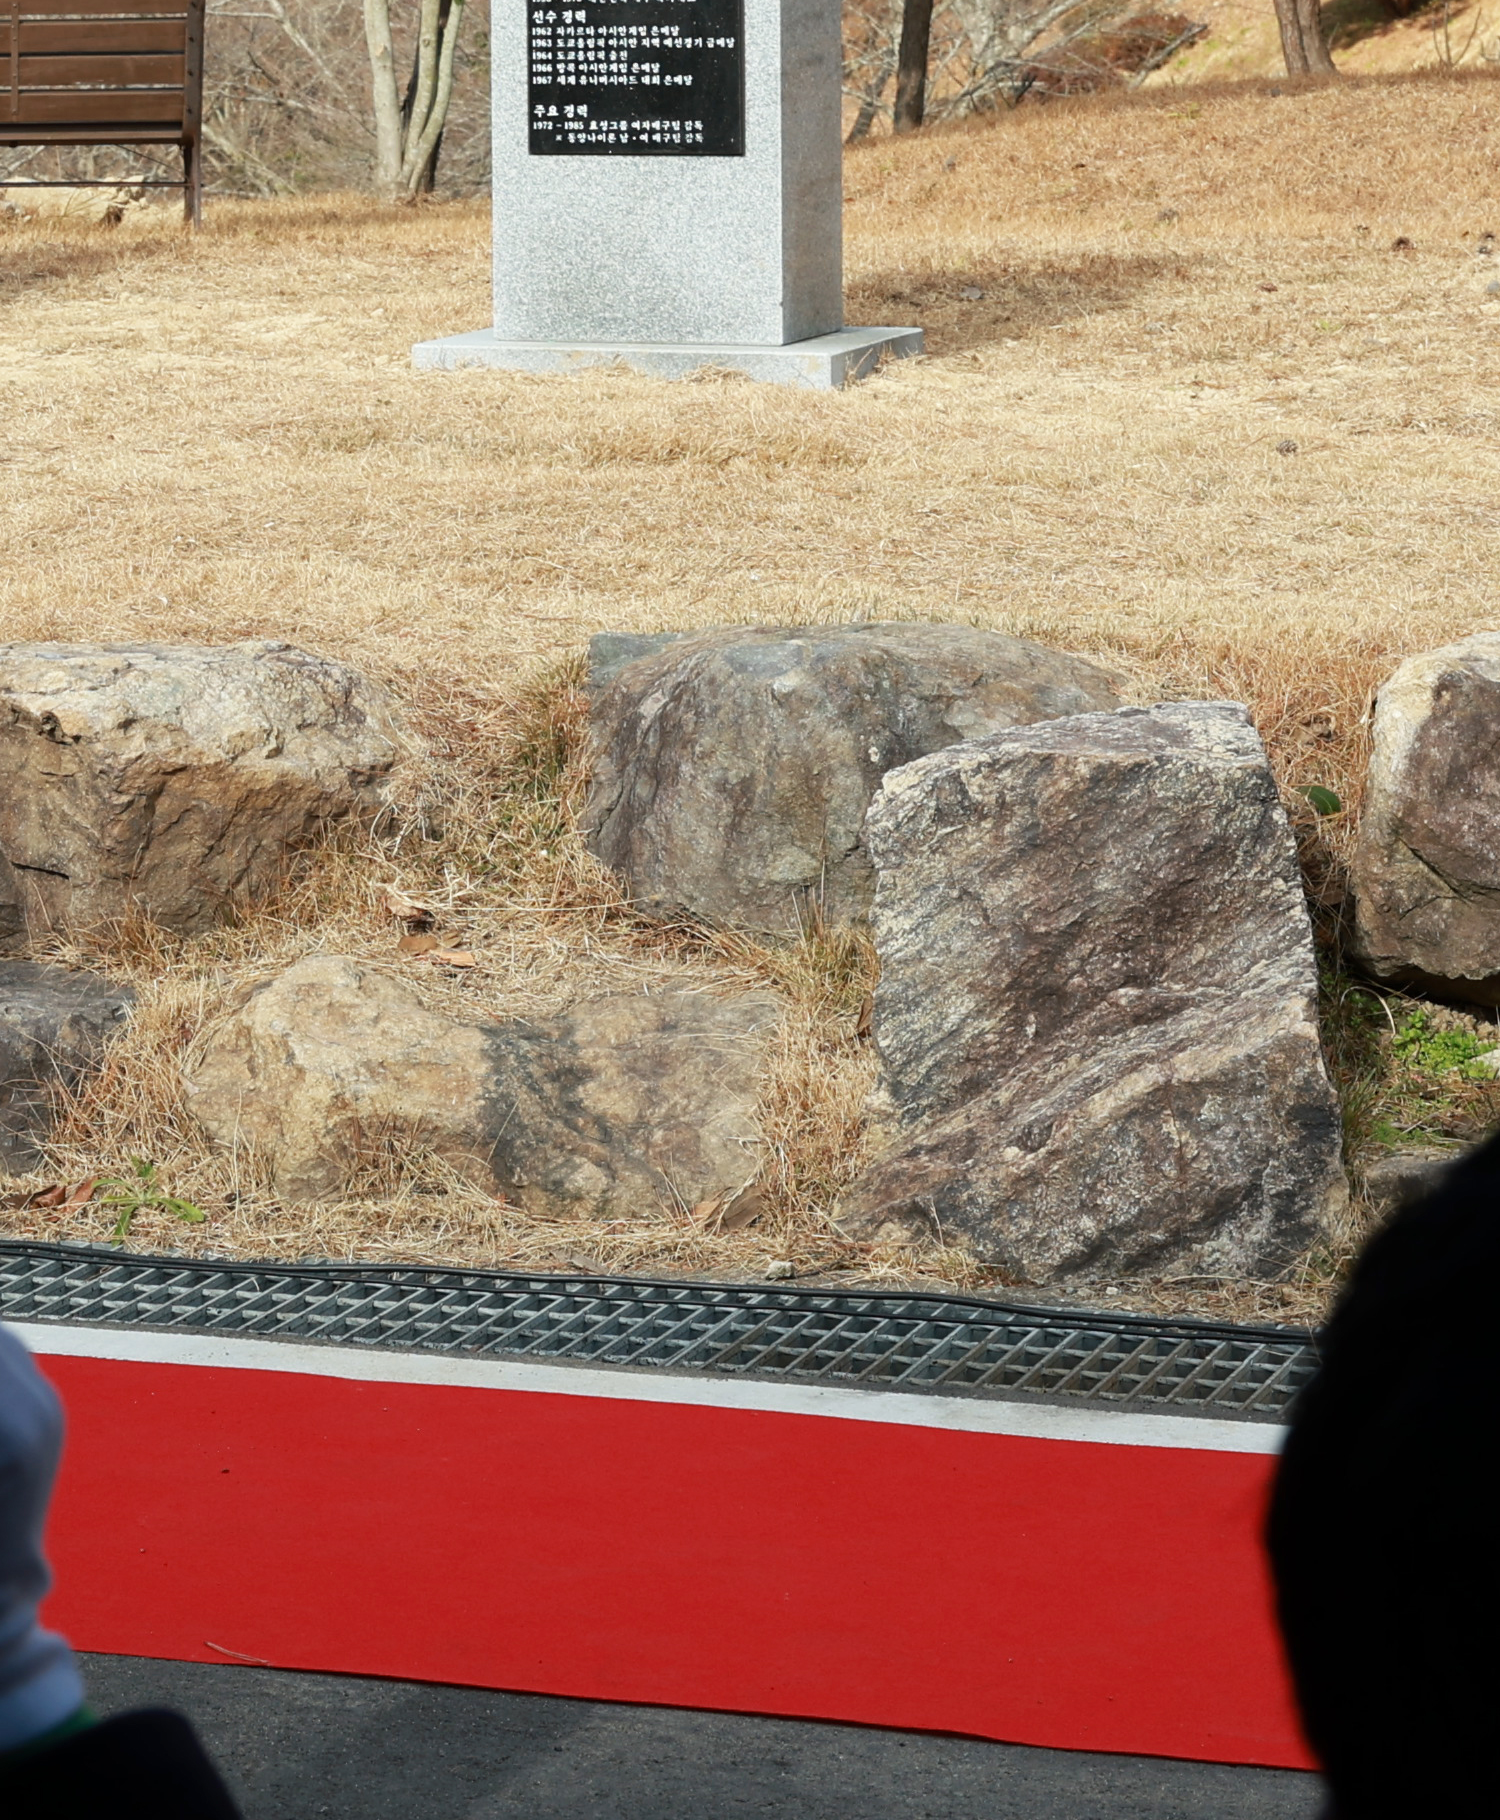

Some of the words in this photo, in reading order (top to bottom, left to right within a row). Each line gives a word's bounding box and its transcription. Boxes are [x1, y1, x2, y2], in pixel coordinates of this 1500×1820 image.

[533, 10, 557, 24] 선수
[562, 10, 586, 24] 경력
[532, 27, 552, 35] 1962
[532, 39, 552, 47] 1963
[533, 50, 552, 60] 1964
[533, 64, 552, 72] 1966
[533, 76, 552, 84] 1967
[534, 105, 559, 118] 주요
[564, 104, 587, 118] 경력
